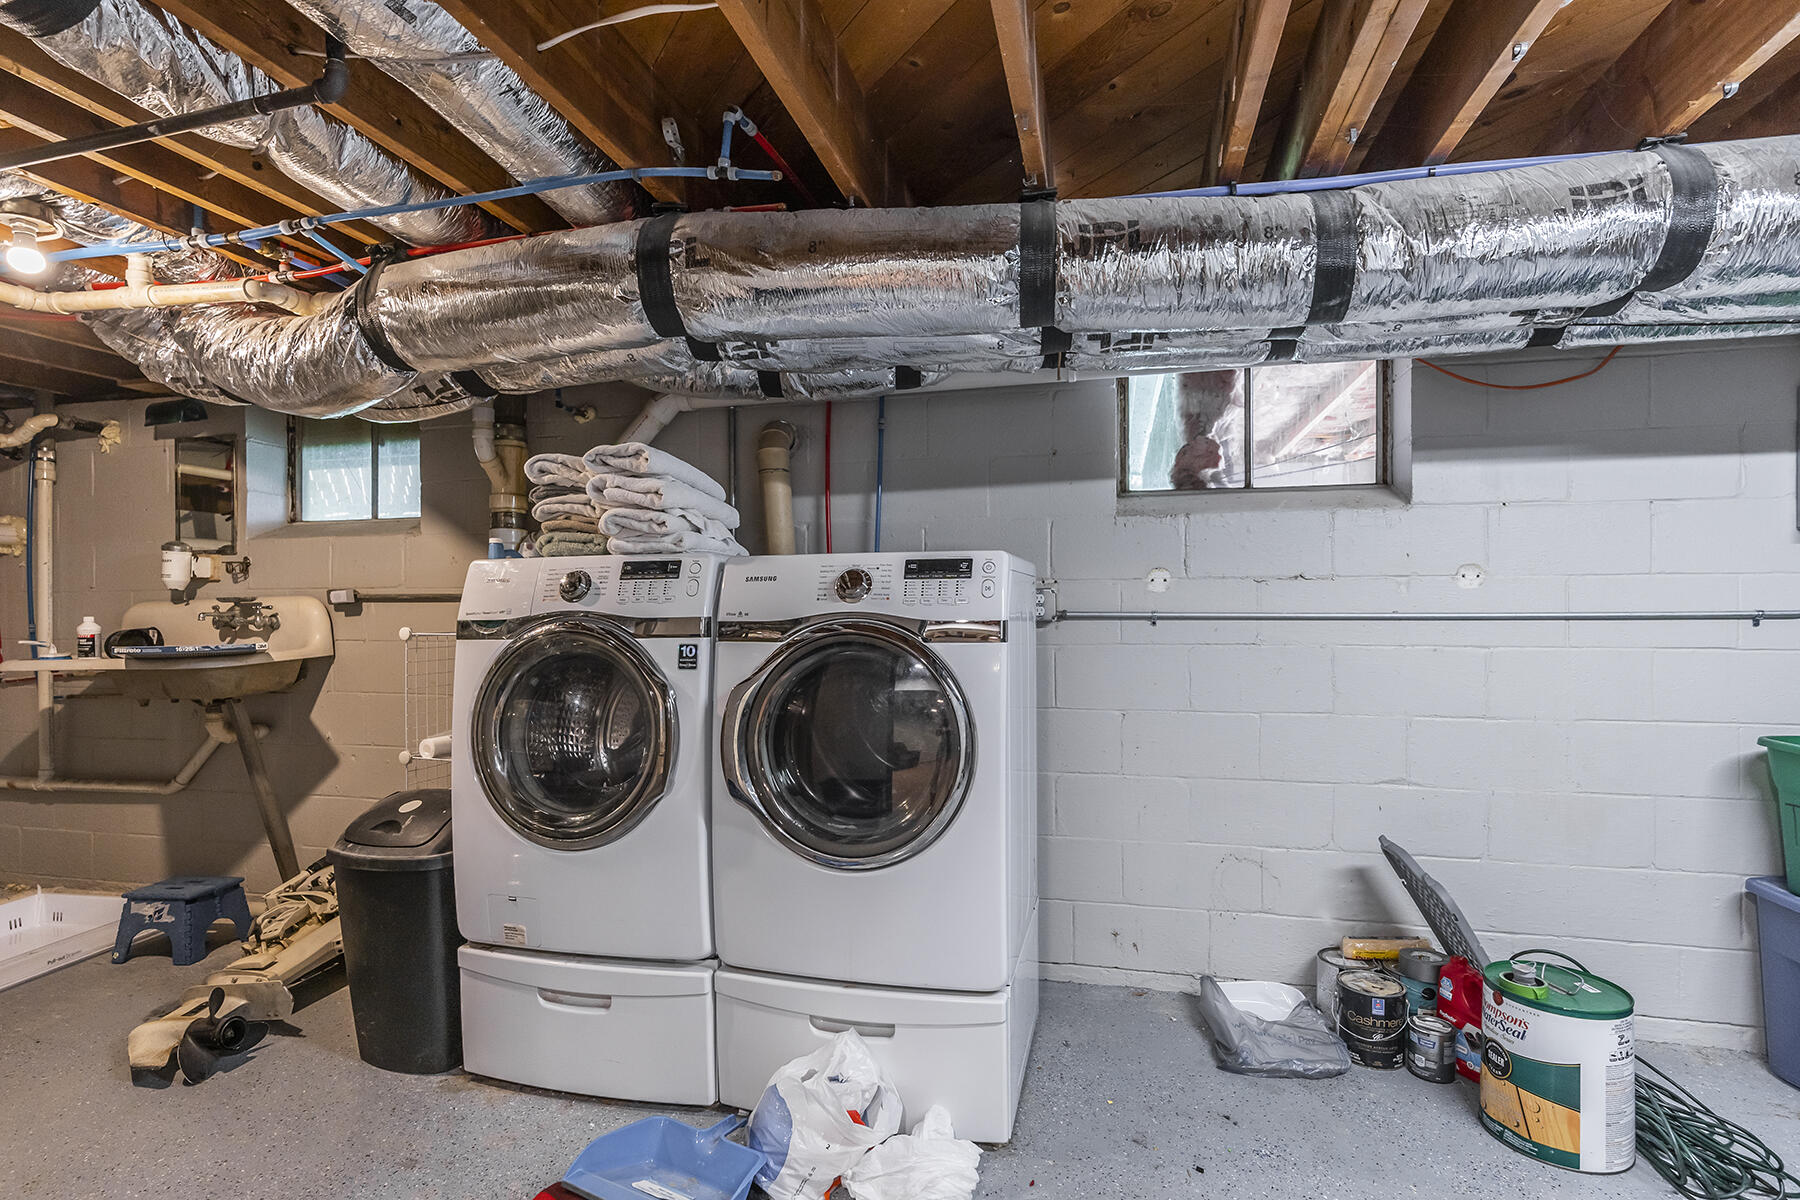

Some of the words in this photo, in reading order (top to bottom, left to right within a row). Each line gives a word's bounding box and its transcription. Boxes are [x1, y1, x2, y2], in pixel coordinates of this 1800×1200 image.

[808, 240, 826, 254] 8"
[1086, 332, 1168, 354] JPL
[412, 378, 464, 404] PL
[744, 575, 778, 583] SAMSUNG
[680, 645, 696, 657] 10
[1347, 1010, 1404, 1028] Cashmere
[1484, 1000, 1530, 1030] ompson's
